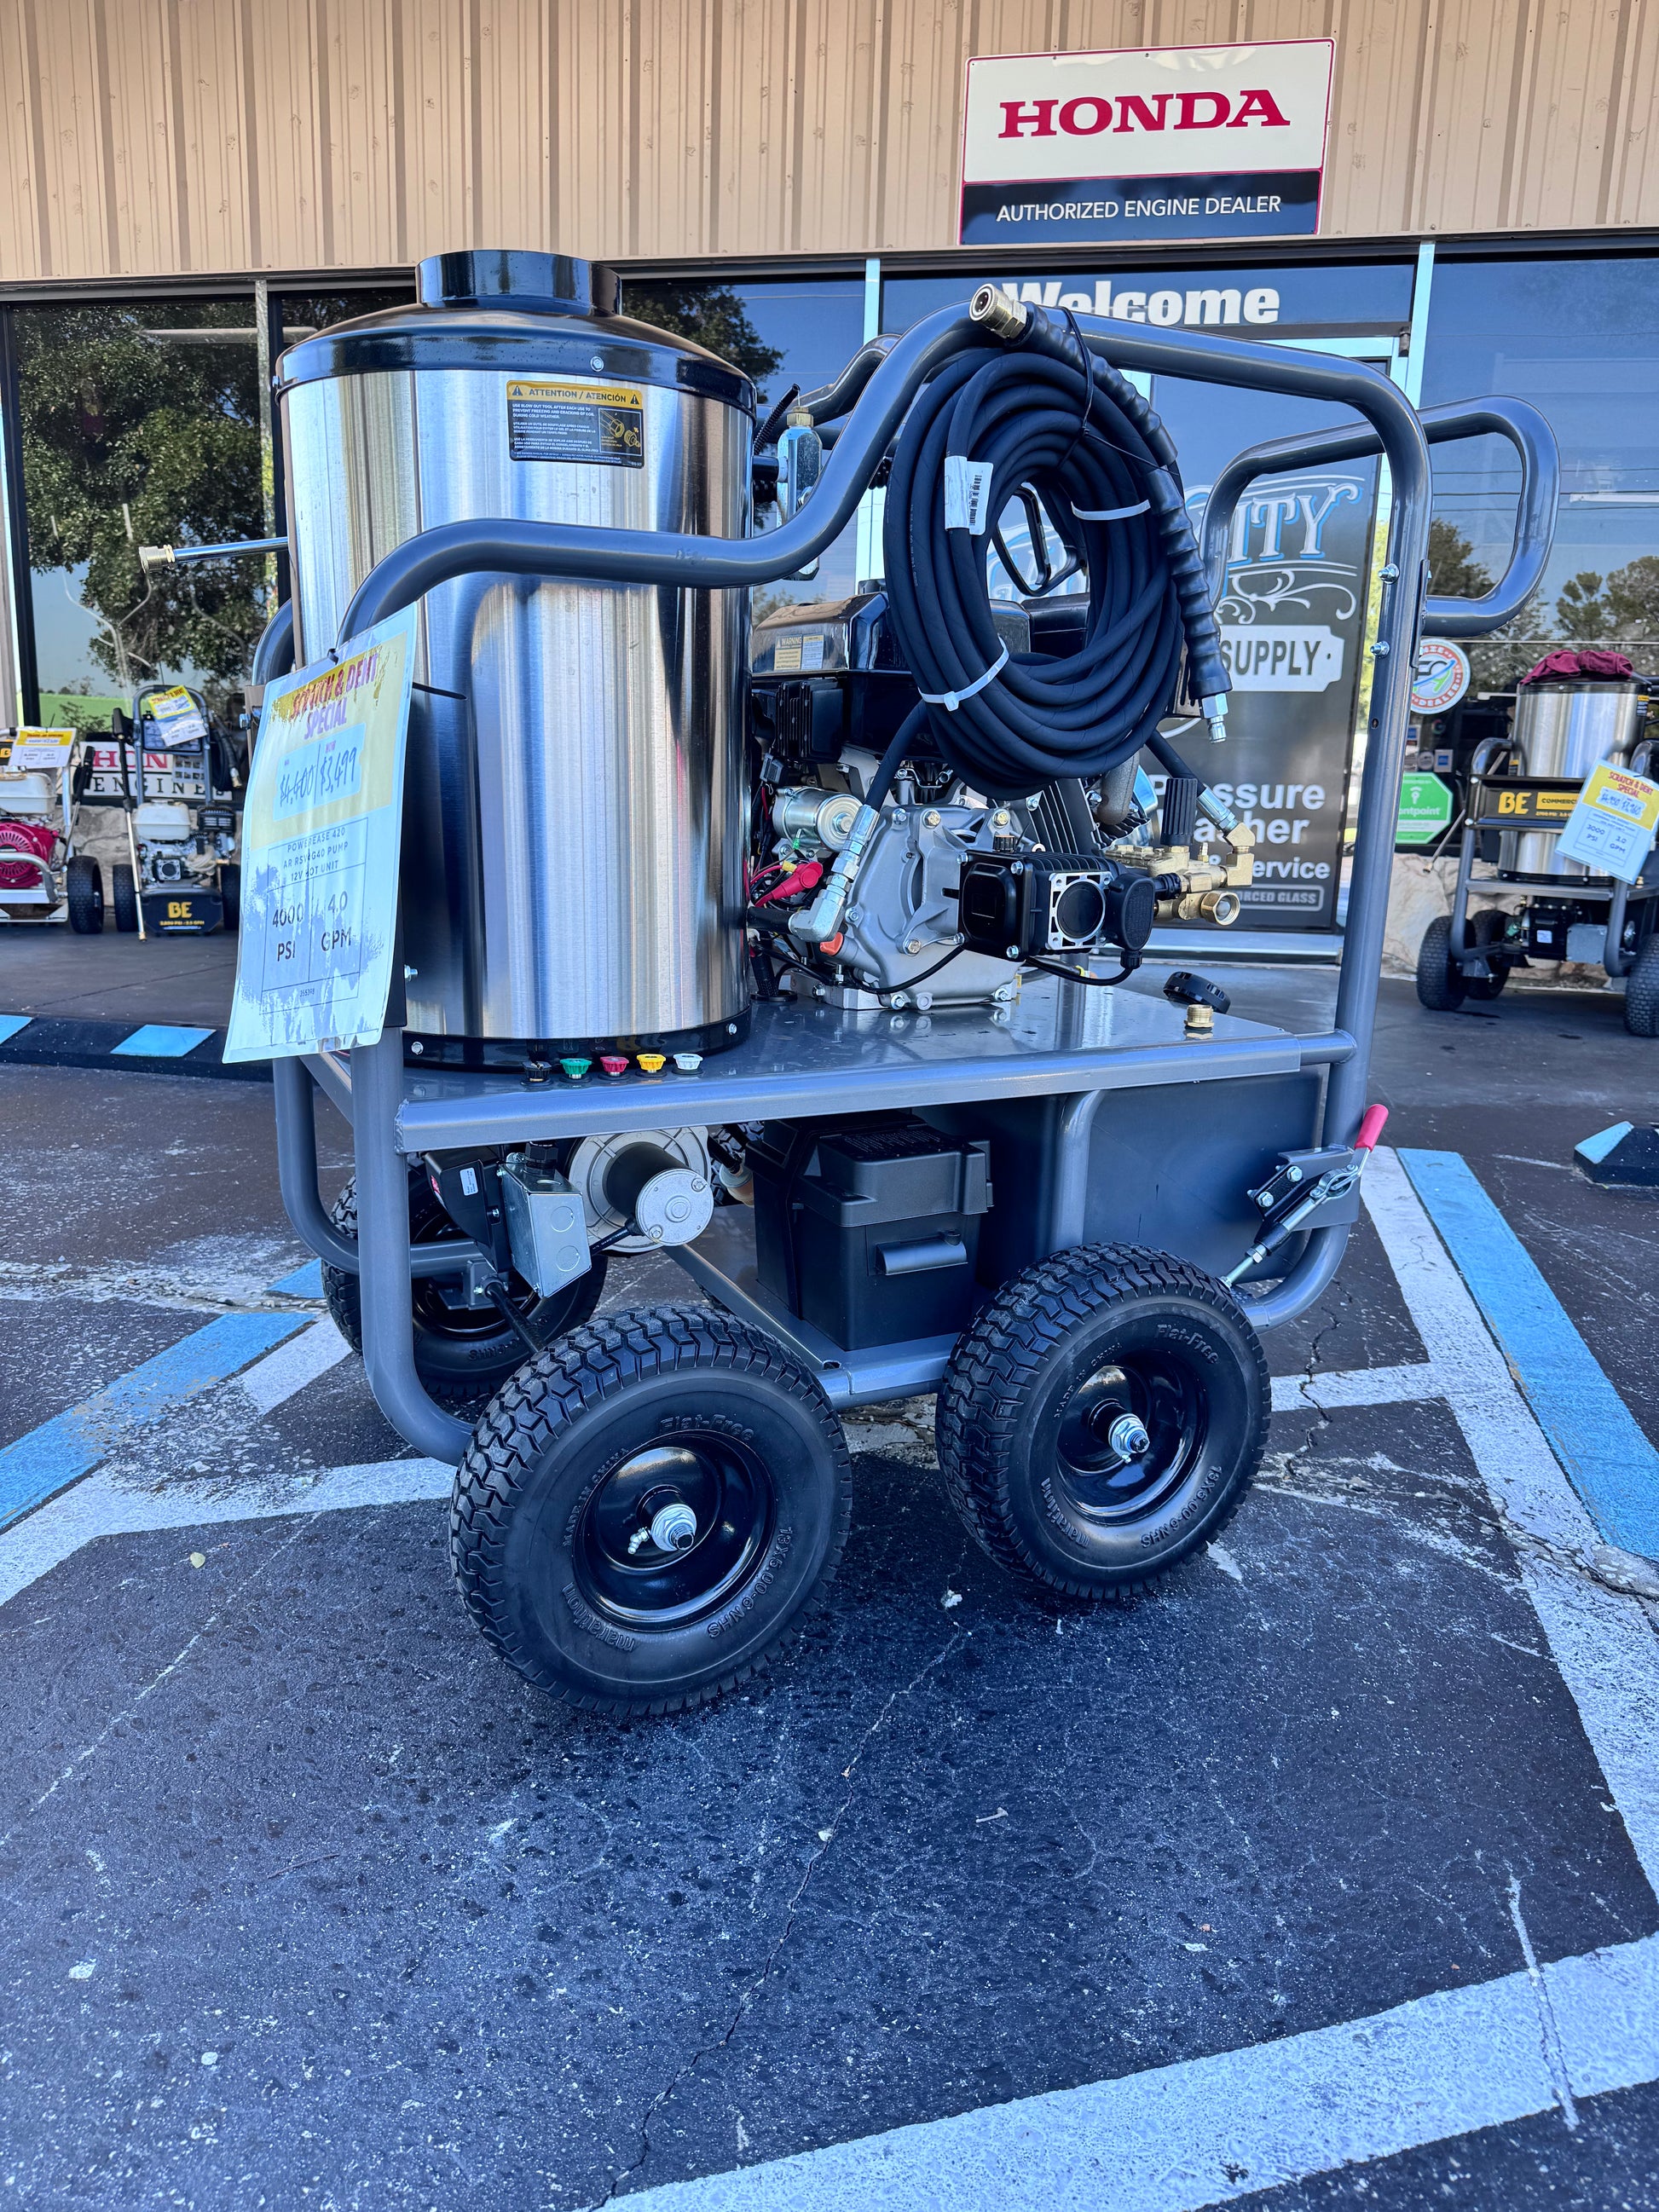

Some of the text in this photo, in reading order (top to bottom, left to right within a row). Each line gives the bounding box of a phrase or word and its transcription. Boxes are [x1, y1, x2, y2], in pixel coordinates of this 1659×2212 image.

[998, 90, 1291, 138] HONDA
[996, 195, 1280, 222] AUTHORIZED ENGINE DEALER
[1002, 280, 1280, 326] Welcome
[529, 389, 577, 399] ATTENTION
[586, 391, 626, 403] ATENCIÓN
[1228, 484, 1360, 563] ITY
[1220, 640, 1321, 676] SUPPLY
[335, 668, 344, 697] &
[346, 653, 378, 692] DENT
[304, 696, 347, 740] SPECIAL
[321, 747, 357, 796] $3,499
[1148, 774, 1326, 811] Pssure
[1498, 792, 1532, 815] BE
[1399, 806, 1441, 817] ntpoint
[283, 858, 292, 869] AR
[327, 840, 349, 855] PUMP
[287, 827, 345, 852] POWEREASE 420
[292, 870, 303, 882] 12V
[321, 859, 339, 873] UNIT
[1252, 857, 1331, 879] ervice
[168, 902, 192, 919] BE
[273, 891, 348, 927] 4000 4.0
[1277, 891, 1316, 904] GLASS
[278, 926, 351, 962] PSI GPM
[660, 1414, 754, 1441] Flat-Free
[1140, 1522, 1171, 1549] NHS
[562, 1581, 636, 1653] marathon
[707, 1604, 746, 1638] NHS
